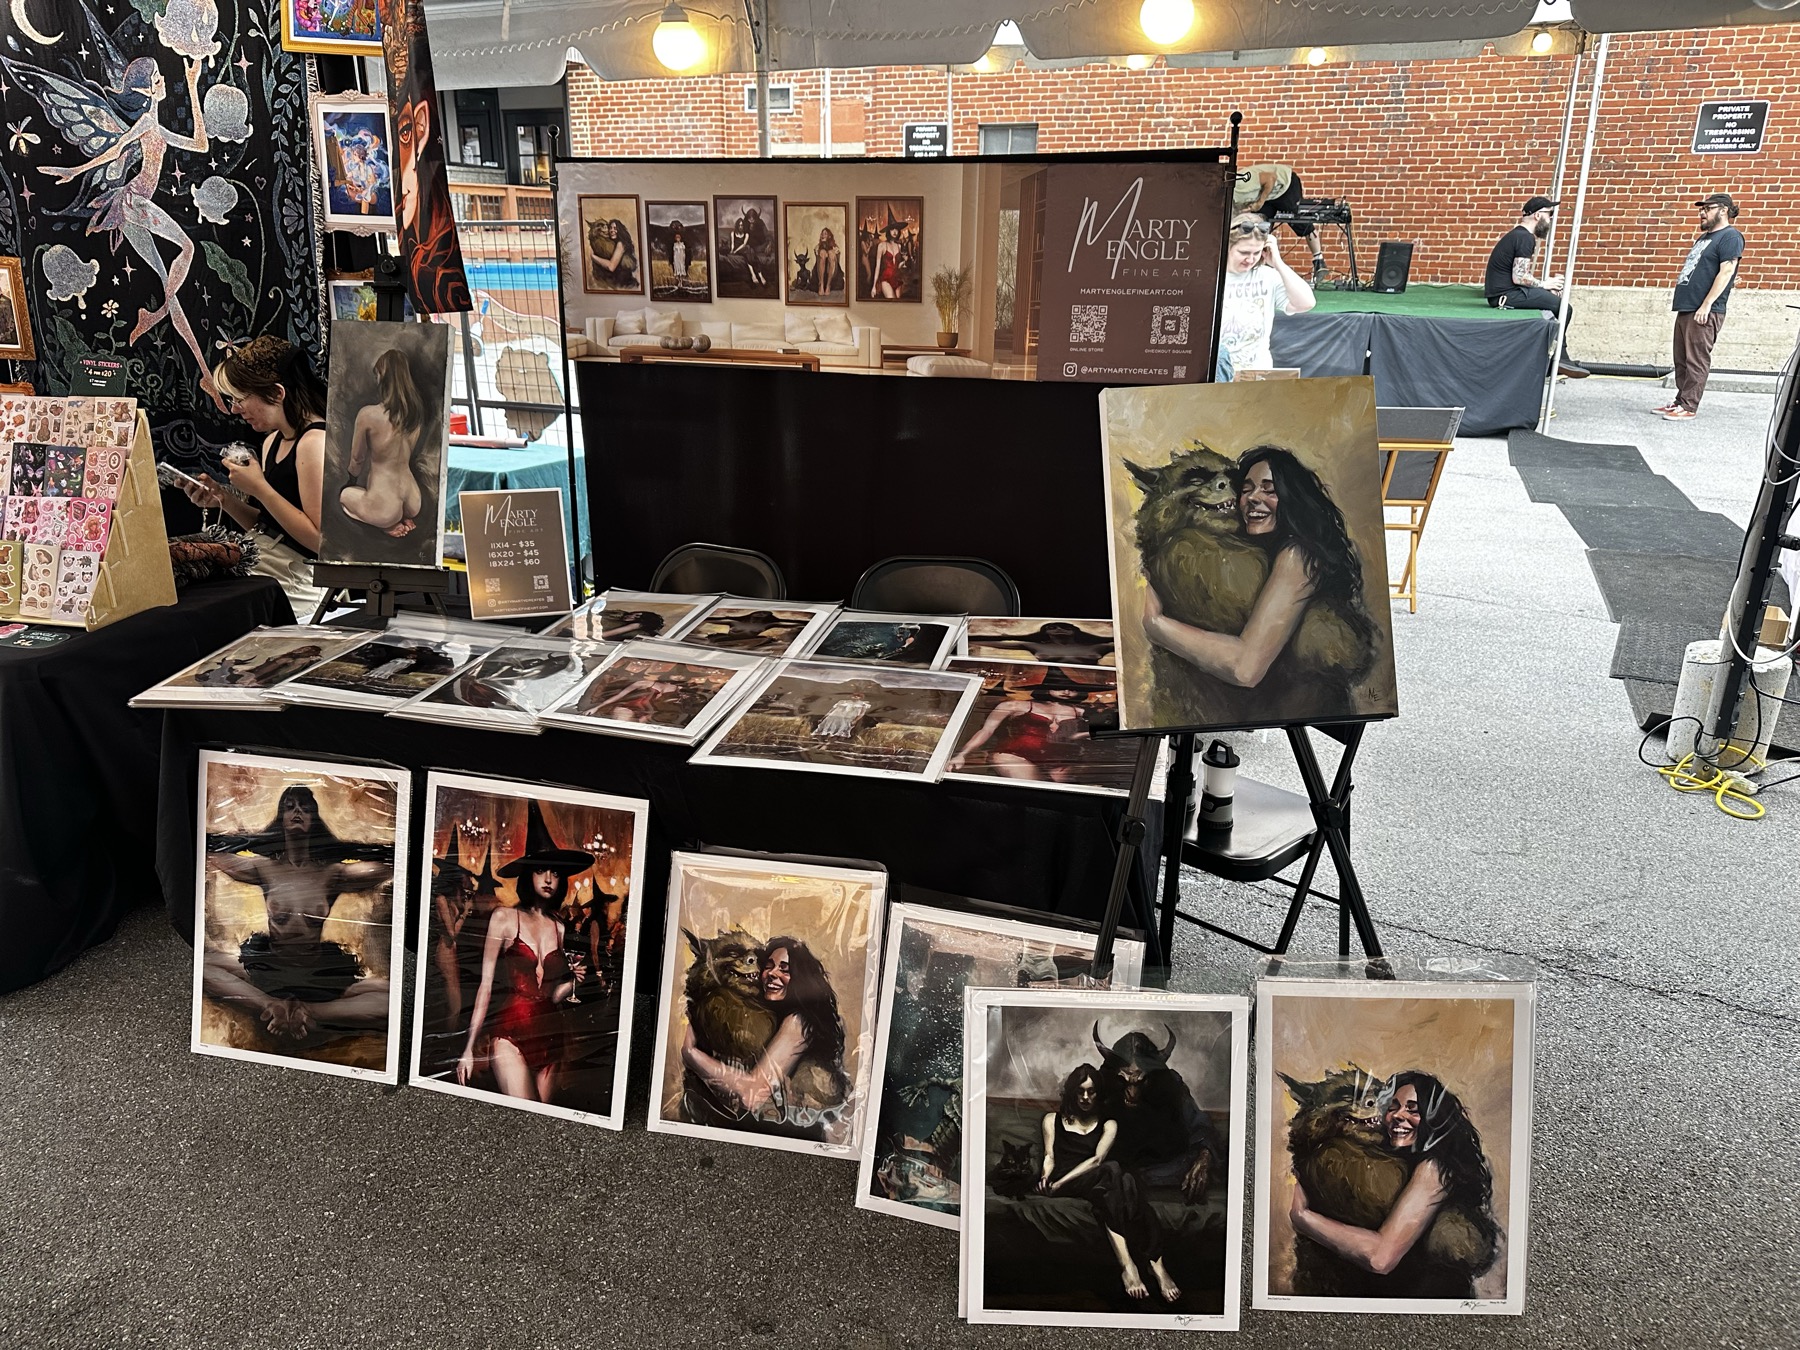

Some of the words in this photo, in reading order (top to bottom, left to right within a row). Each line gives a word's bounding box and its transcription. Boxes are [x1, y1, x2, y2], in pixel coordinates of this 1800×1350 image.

[1711, 112, 1753, 120] PROPERTY
[1703, 128, 1756, 136] TRESPASSING
[1067, 176, 1199, 280] MARTY
[1105, 239, 1191, 261] ENGLE
[1122, 268, 1160, 277] FINE
[1171, 268, 1203, 278] ART
[1079, 288, 1184, 296] MARTYENGLEFINEART.COM
[1226, 280, 1268, 299] TEFUL
[97, 360, 120, 369] STICKERS
[1080, 366, 1169, 375] @ARTYMARTYCREATES
[484, 494, 538, 537] MARTY
[500, 517, 537, 528] ENGLE
[490, 541, 510, 549] 11X14
[518, 540, 536, 548] $35
[488, 550, 514, 559] 16X20
[523, 549, 540, 557] $45
[489, 559, 515, 567] 18X24
[523, 558, 540, 566] $60
